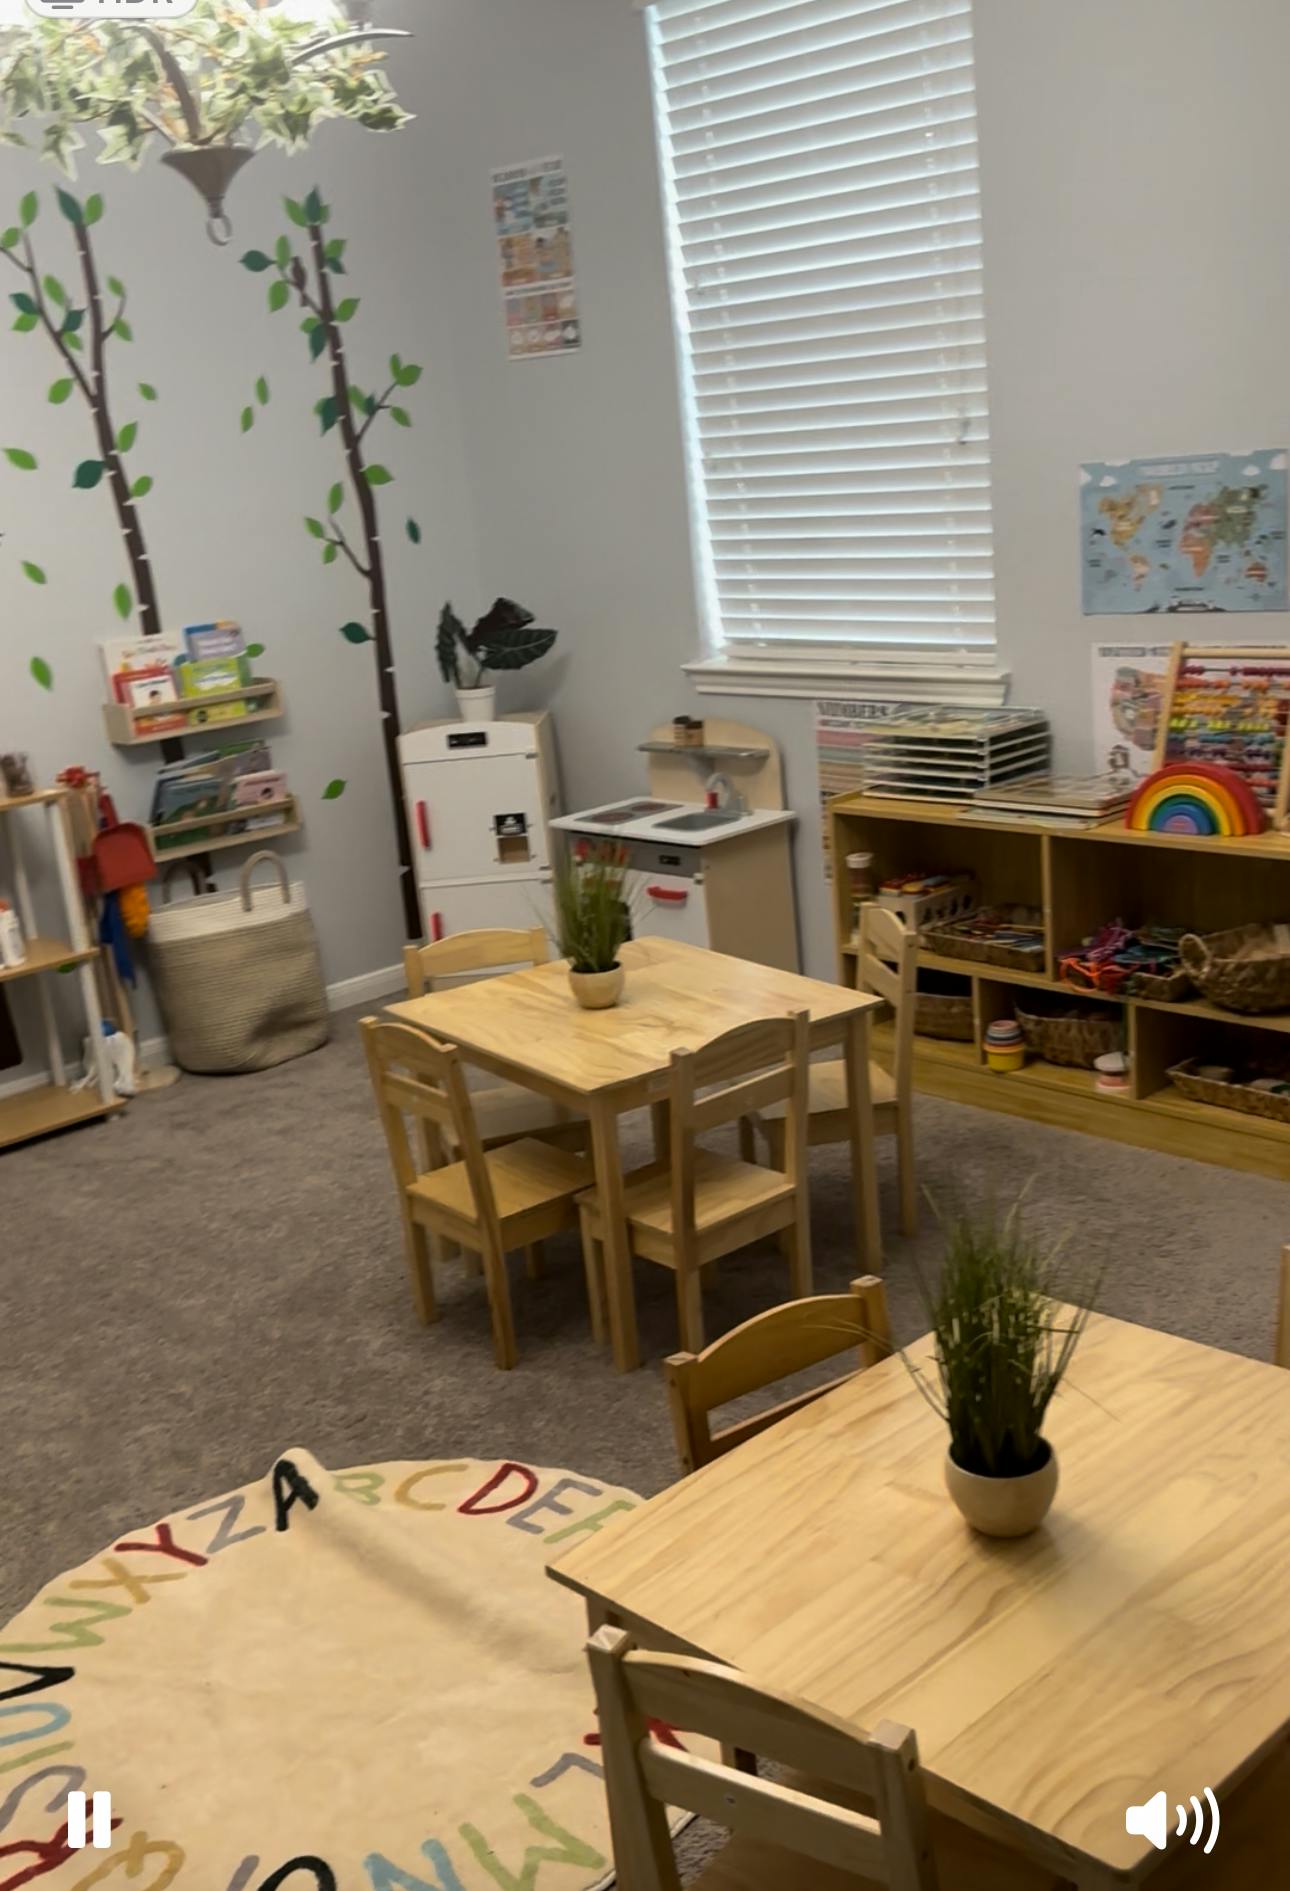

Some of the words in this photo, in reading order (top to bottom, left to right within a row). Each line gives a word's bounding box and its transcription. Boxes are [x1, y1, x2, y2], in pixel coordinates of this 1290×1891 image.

[273, 1459, 319, 1532] A
[394, 1463, 469, 1512] C
[457, 1462, 539, 1515] D
[506, 1478, 603, 1535] E
[114, 1523, 208, 1567] Y
[186, 1494, 266, 1554] Z
[68, 1558, 188, 1604] X
